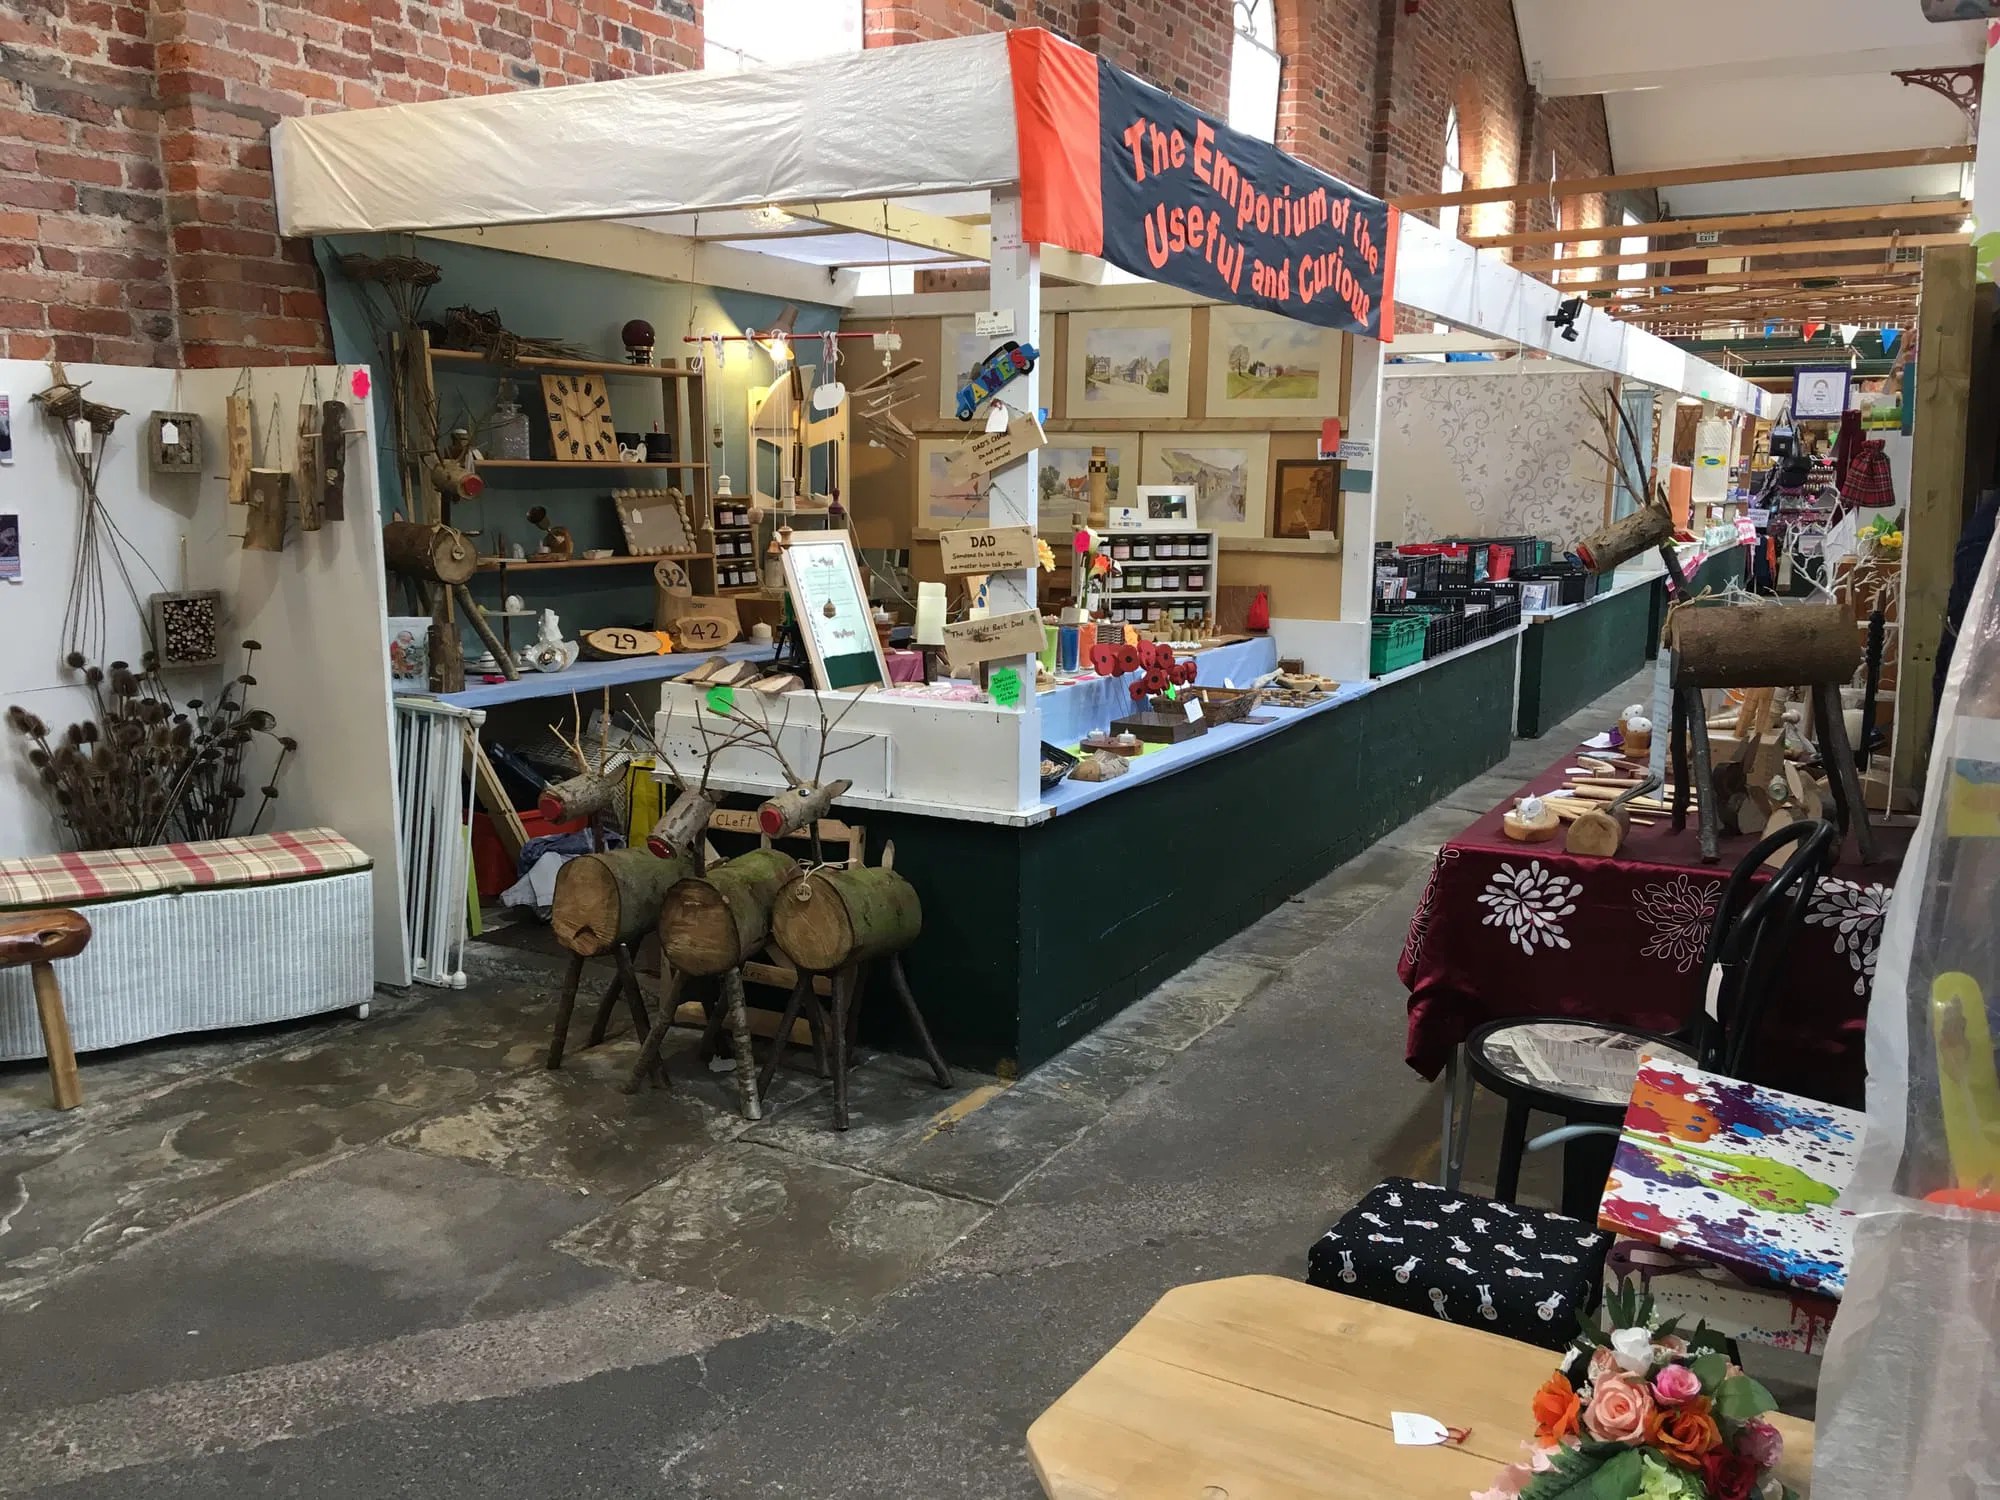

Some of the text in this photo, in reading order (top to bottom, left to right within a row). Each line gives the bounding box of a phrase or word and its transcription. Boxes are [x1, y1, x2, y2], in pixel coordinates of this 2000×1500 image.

[1124, 117, 1379, 275] The Emporium of the
[1144, 203, 1369, 327] Useful and Curious
[970, 535, 996, 548] DAD
[659, 568, 687, 587] 32
[691, 622, 721, 640] 42
[607, 633, 637, 650] 29
